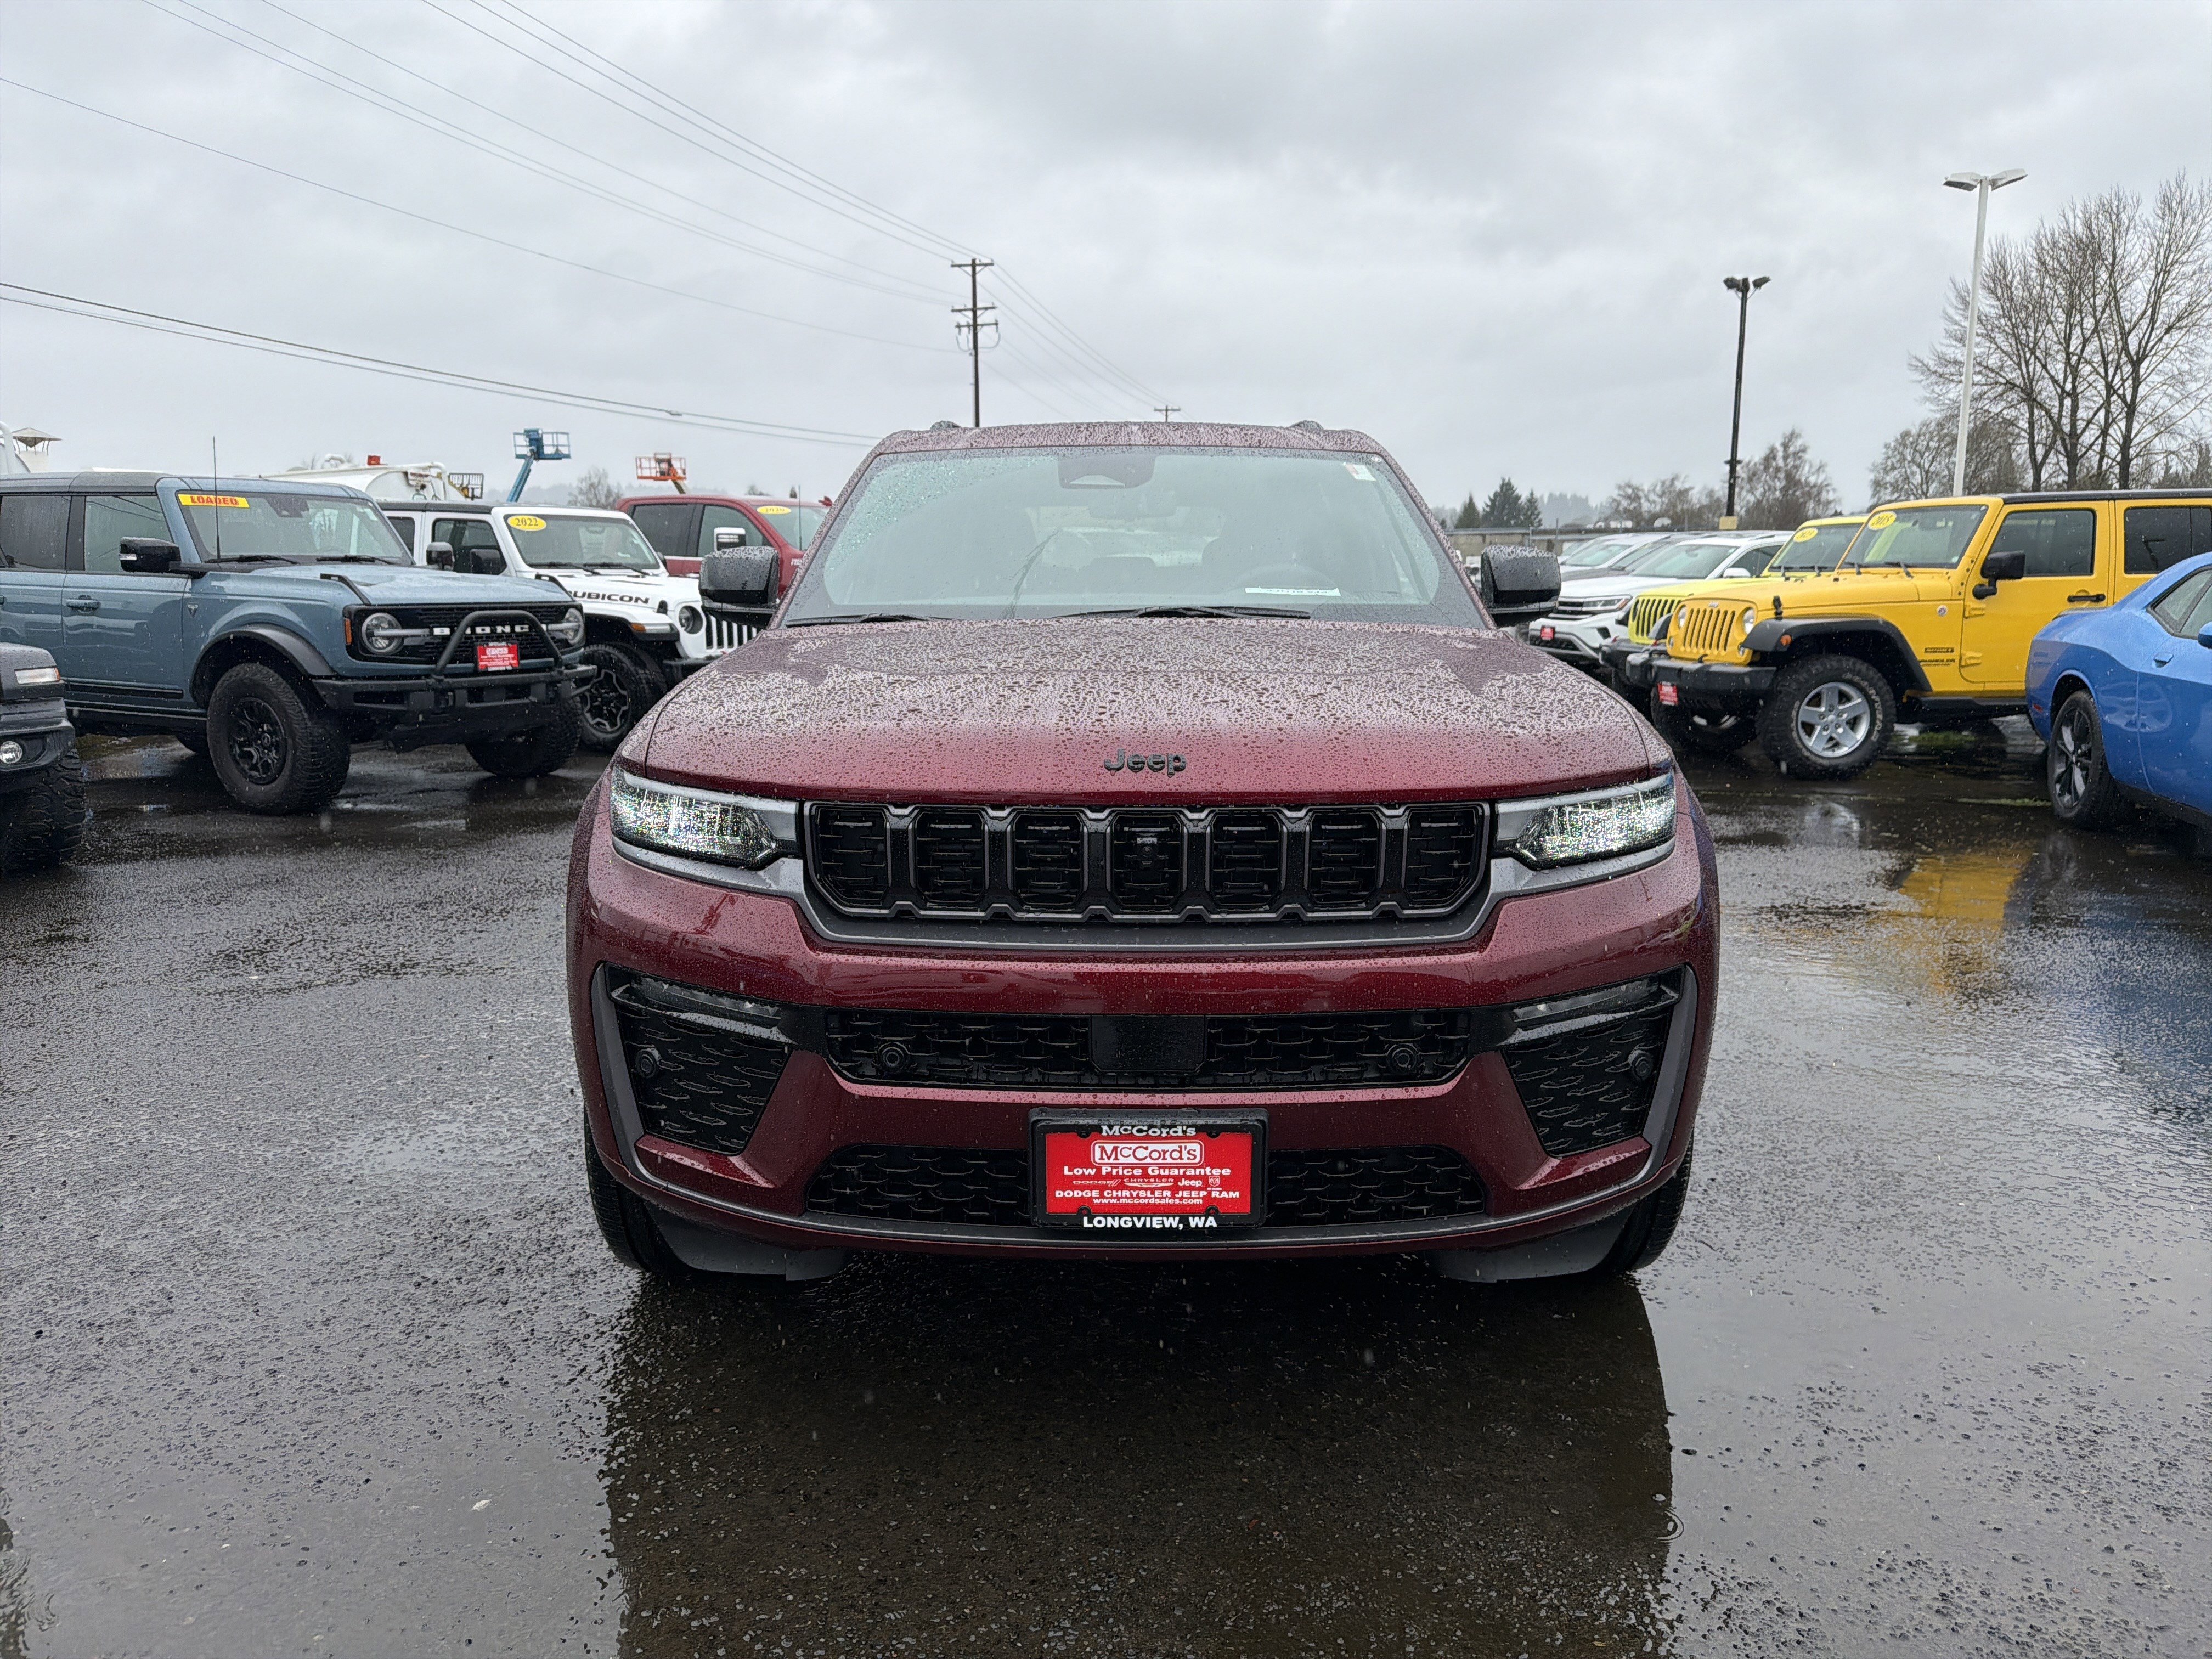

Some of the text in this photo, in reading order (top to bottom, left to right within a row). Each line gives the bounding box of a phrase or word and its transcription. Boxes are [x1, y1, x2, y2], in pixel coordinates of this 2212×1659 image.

[190, 495, 240, 505] LOADED
[515, 517, 539, 527] 2022
[1104, 748, 1187, 777] Jeep
[1101, 1125, 1197, 1137] McCord's
[1098, 1145, 1197, 1161] McCord's
[1064, 1165, 1231, 1176] Low Price Guarantee
[1177, 1178, 1203, 1187] Jeep
[1083, 1216, 1218, 1231] LONGVIEW, WA
